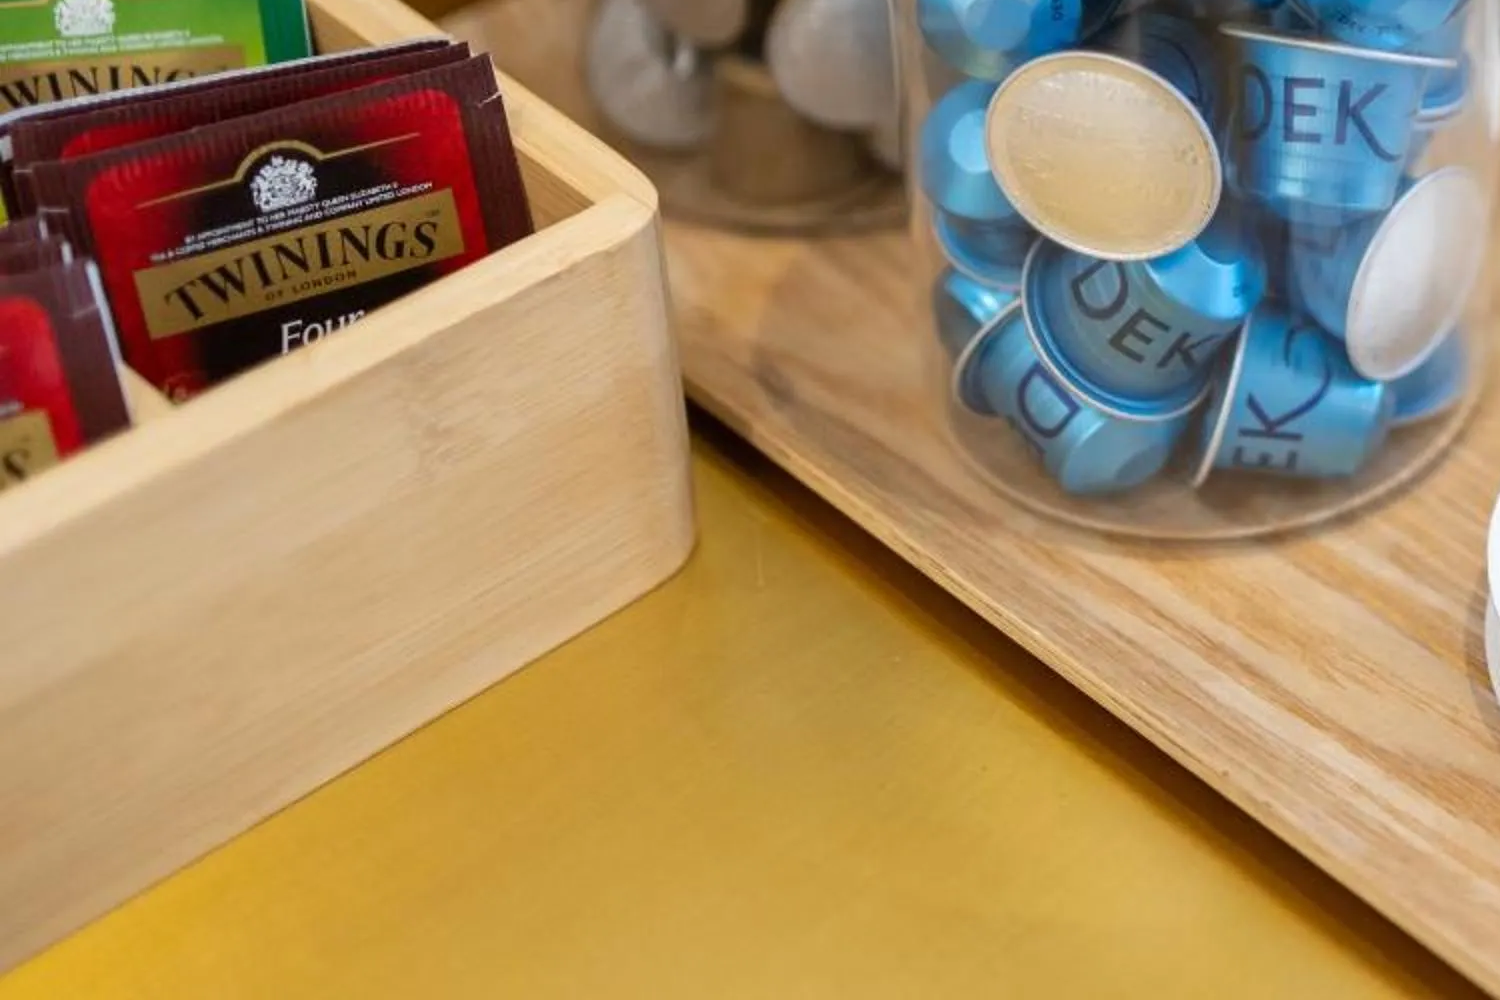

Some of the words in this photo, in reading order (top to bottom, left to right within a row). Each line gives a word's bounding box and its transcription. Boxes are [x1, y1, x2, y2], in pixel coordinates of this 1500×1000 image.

[1239, 63, 1400, 163] DEK
[164, 220, 439, 322] TWININGS
[291, 269, 358, 295] LONDON
[1070, 257, 1223, 371] DEK
